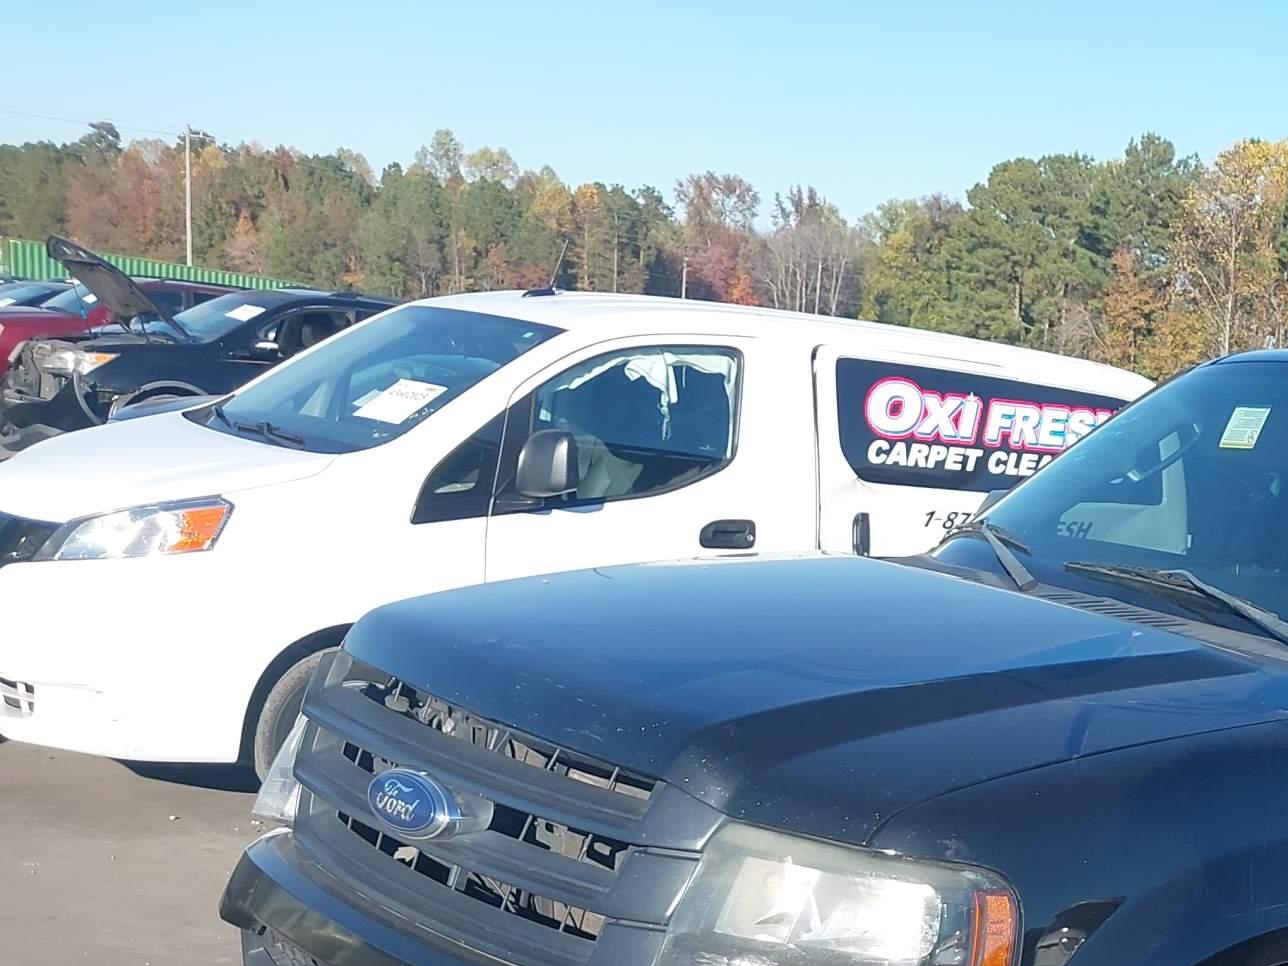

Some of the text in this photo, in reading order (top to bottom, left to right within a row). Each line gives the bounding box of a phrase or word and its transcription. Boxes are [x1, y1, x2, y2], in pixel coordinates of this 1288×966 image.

[984, 397, 1116, 451] FRES
[867, 439, 983, 472] CARPET
[924, 510, 977, 529] 1-87
